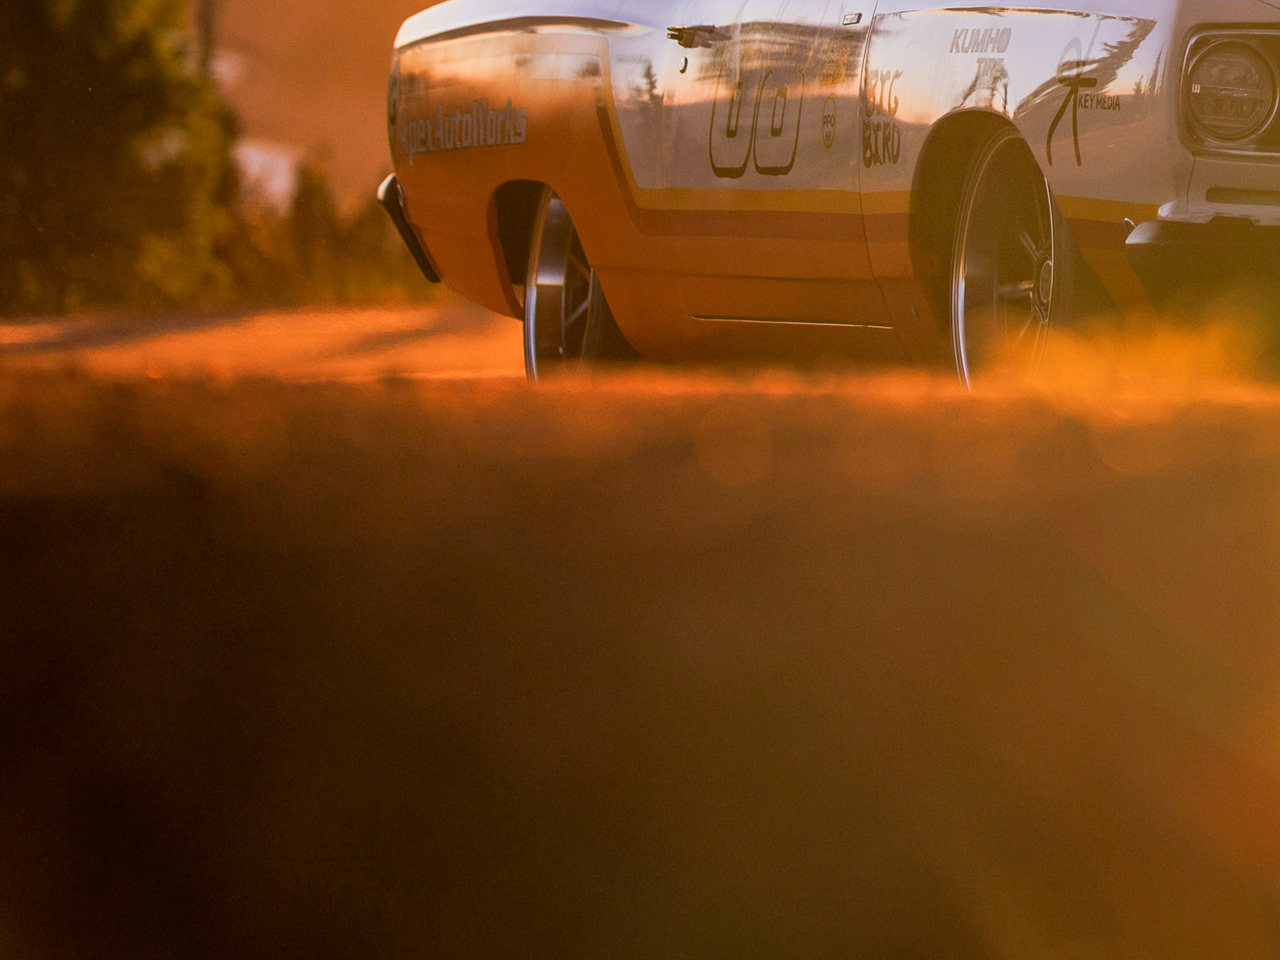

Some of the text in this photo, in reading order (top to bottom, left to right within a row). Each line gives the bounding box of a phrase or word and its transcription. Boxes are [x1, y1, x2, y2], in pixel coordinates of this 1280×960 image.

[949, 27, 1012, 54] KUMHO
[976, 57, 1005, 76] TIRE
[864, 69, 903, 118] BIG
[1077, 93, 1121, 111] KEY MEDIA
[862, 119, 901, 169] BIRD
